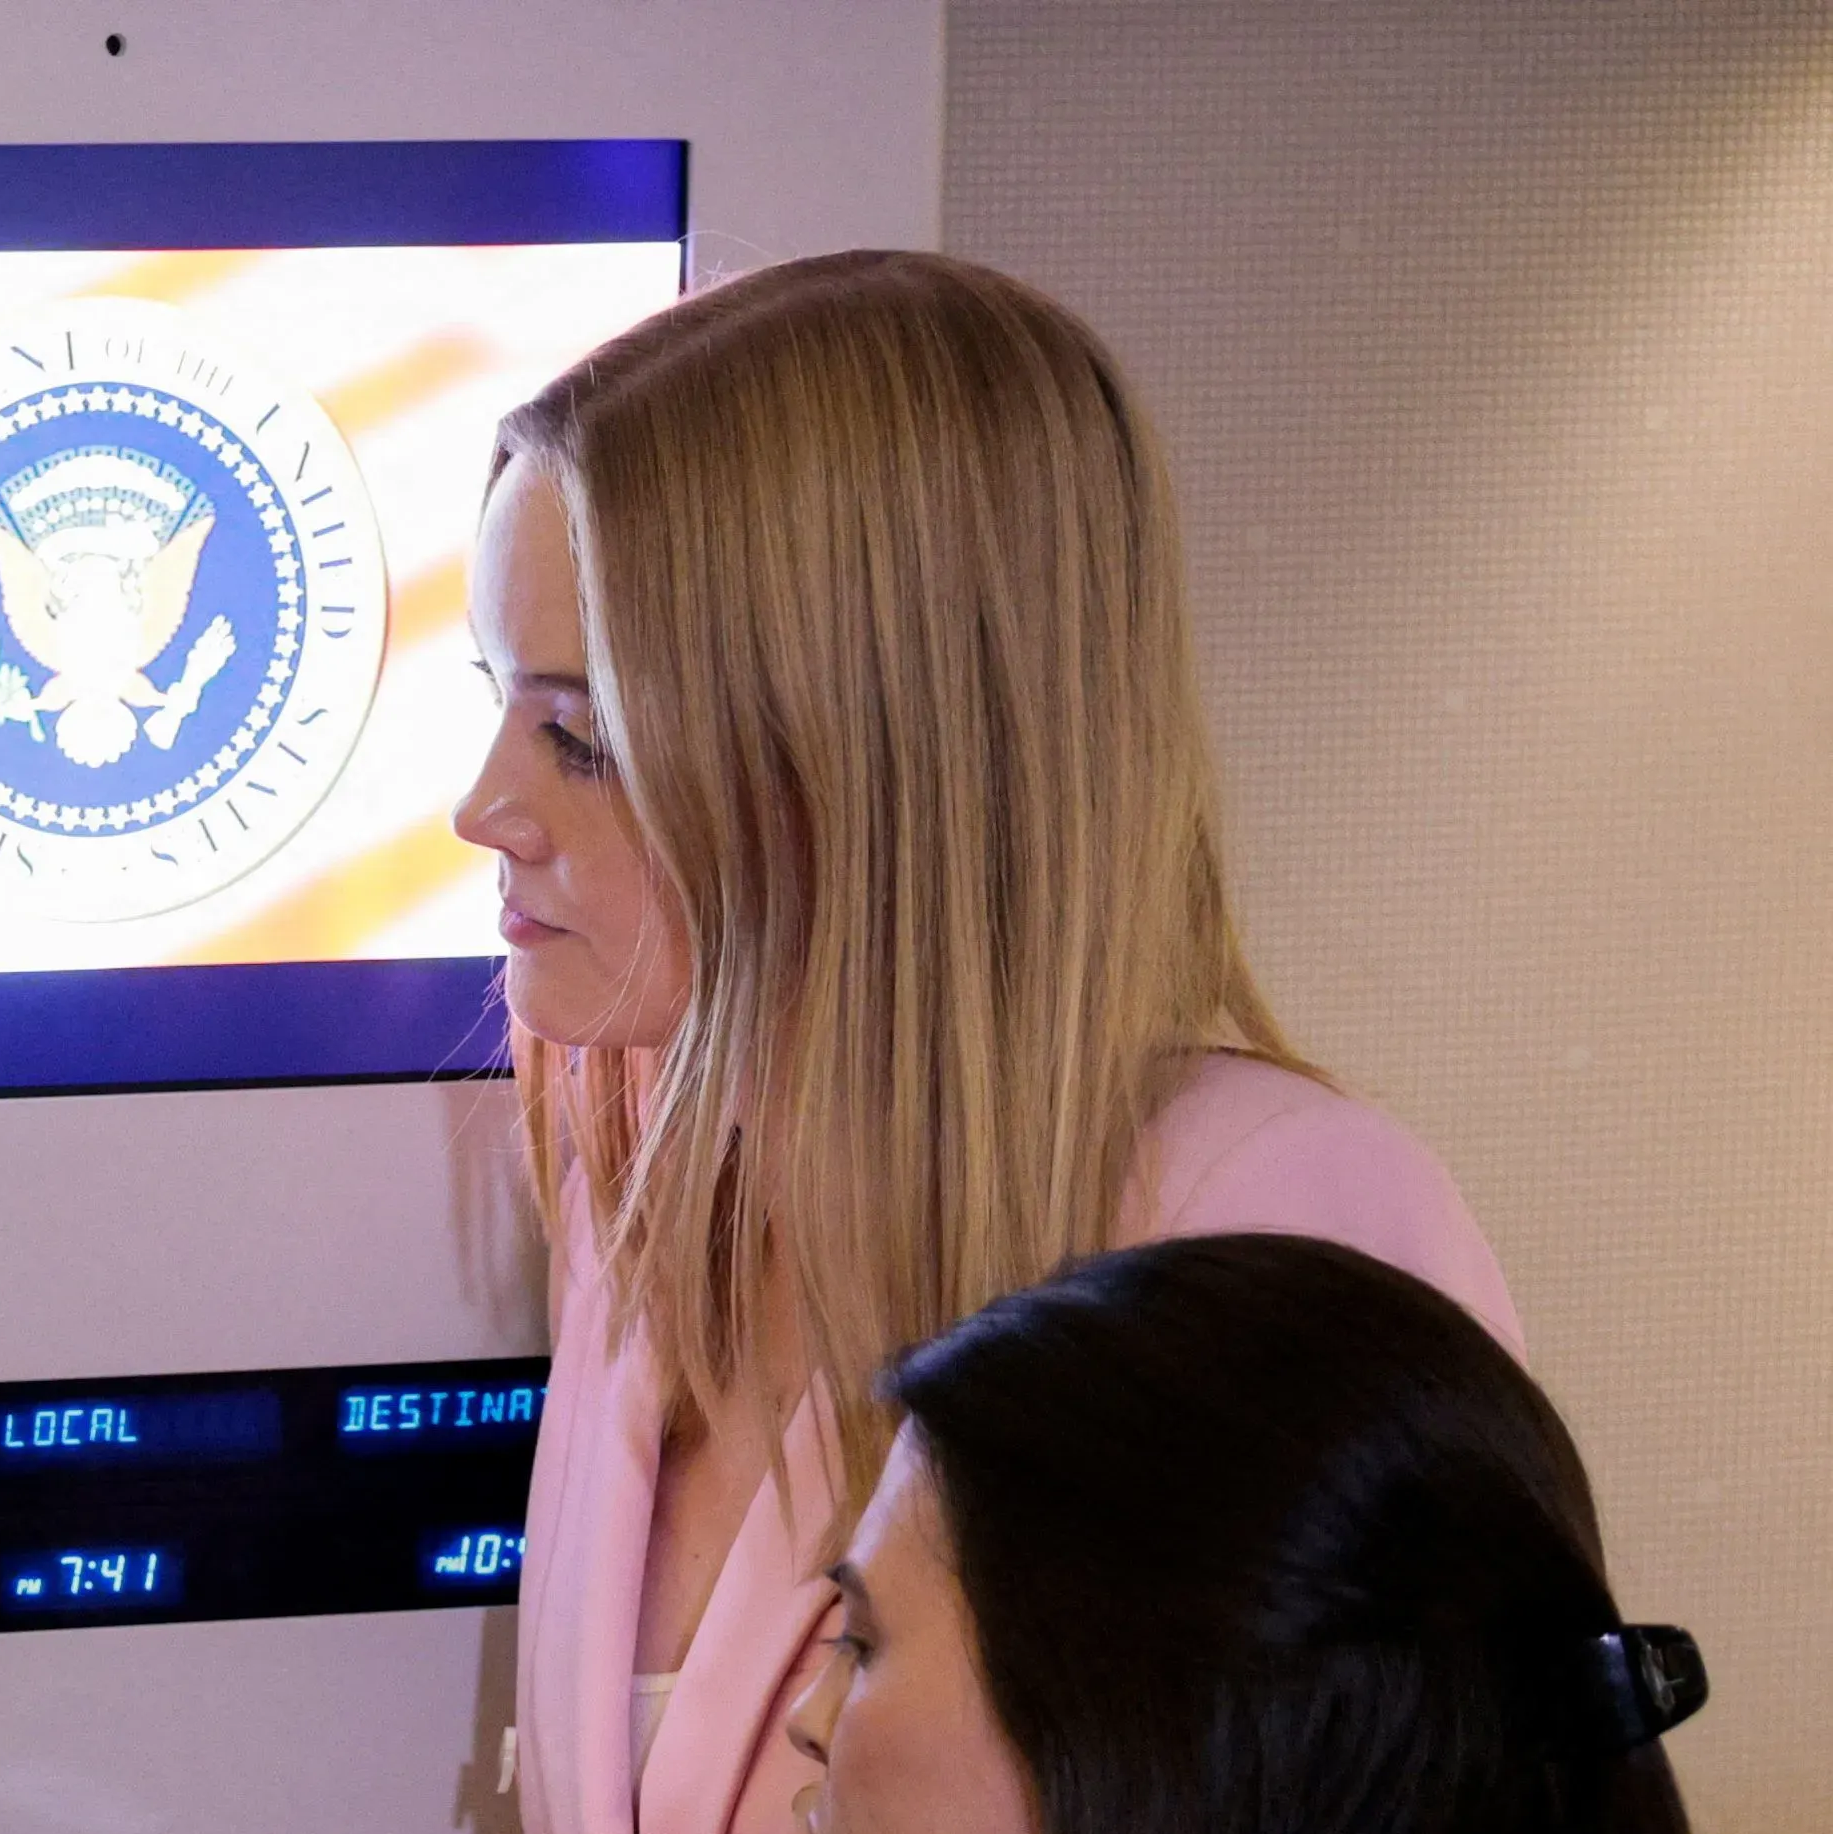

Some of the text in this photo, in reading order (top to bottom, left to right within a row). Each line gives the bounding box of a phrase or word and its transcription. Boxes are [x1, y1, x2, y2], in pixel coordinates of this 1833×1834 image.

[4, 1408, 139, 1447] LOCAL
[343, 1387, 549, 1432] DESTINA
[16, 1553, 158, 1596] PM 7:41
[458, 1533, 527, 1575] 10:
